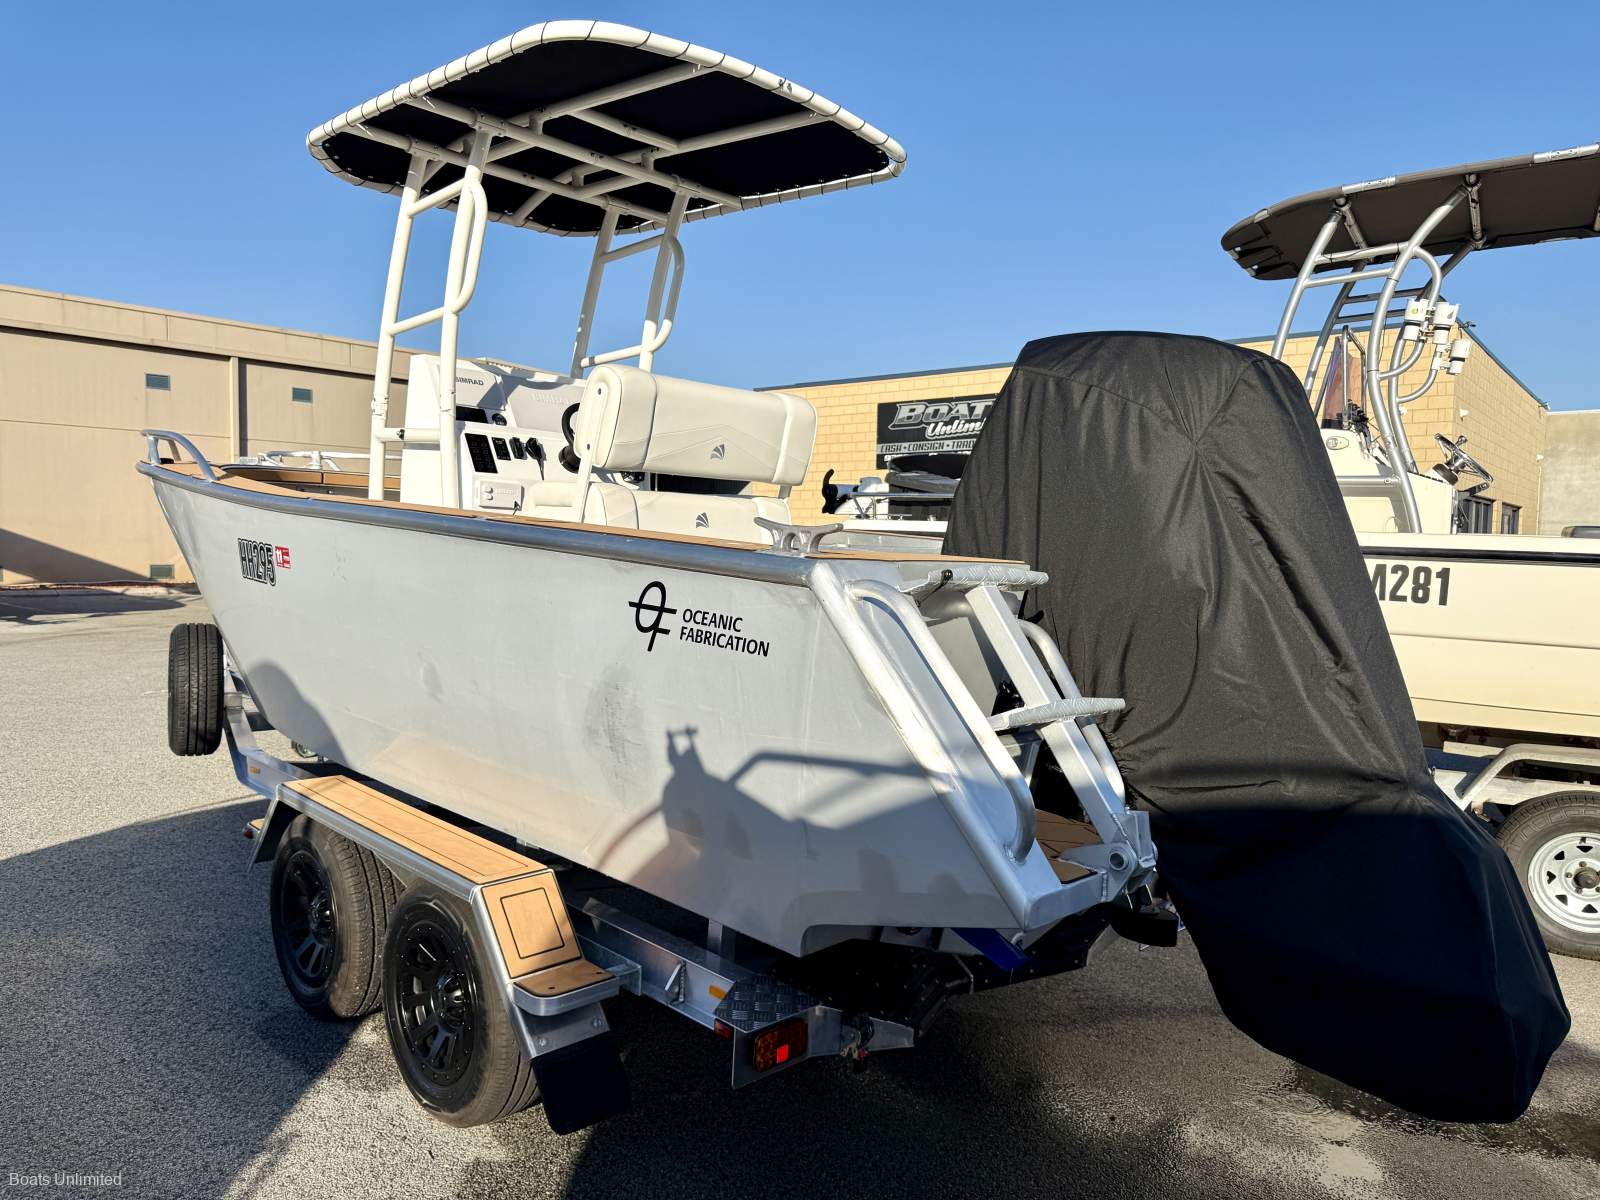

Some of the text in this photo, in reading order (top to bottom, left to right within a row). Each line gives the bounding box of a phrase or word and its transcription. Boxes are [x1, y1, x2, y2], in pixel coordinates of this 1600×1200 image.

[926, 418, 986, 438] Unlim
[881, 443, 902, 453] CASH
[908, 440, 944, 452] CONSIGN
[682, 608, 743, 633] OCEANIC
[679, 626, 770, 657] FABRICATION
